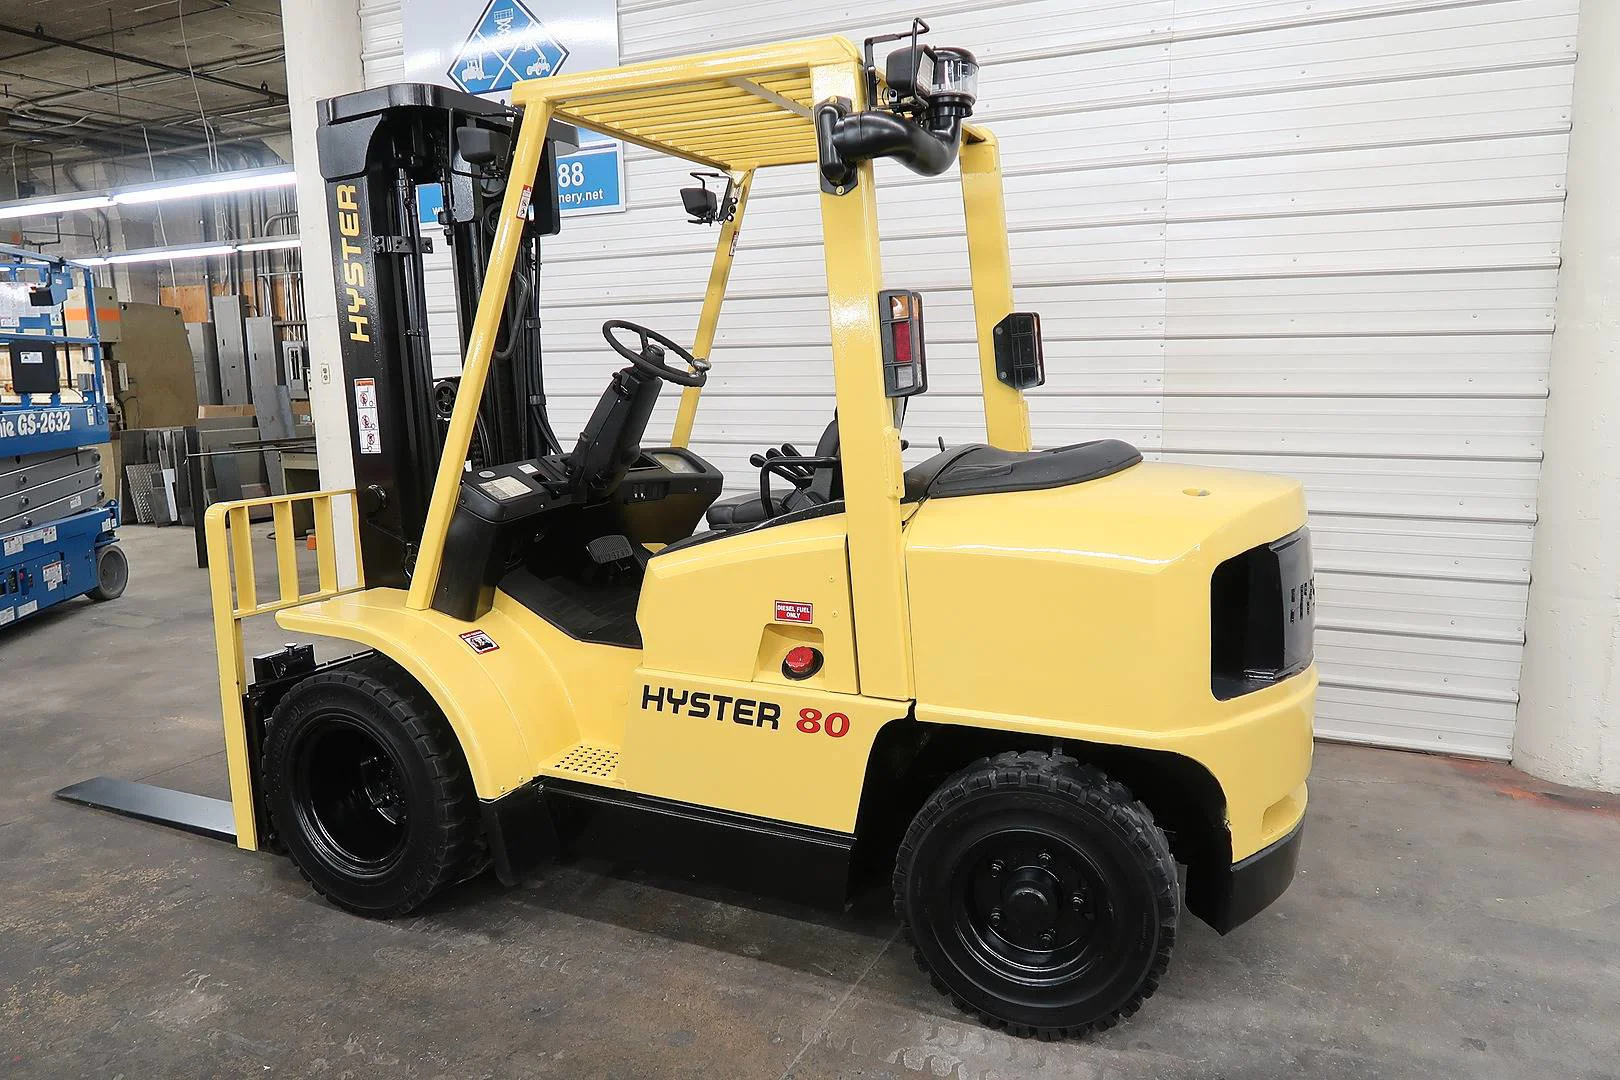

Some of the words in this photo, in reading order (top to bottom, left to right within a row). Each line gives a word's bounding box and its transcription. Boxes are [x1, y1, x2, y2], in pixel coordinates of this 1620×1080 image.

[558, 162, 584, 188] 88
[337, 184, 370, 343] HYSTER
[17, 411, 71, 436] GS-2632
[777, 604, 795, 612] DIESEL
[796, 606, 810, 614] FUEL
[786, 611, 801, 619] ONLY
[641, 684, 781, 730] HYSTER
[796, 707, 850, 738] 80
